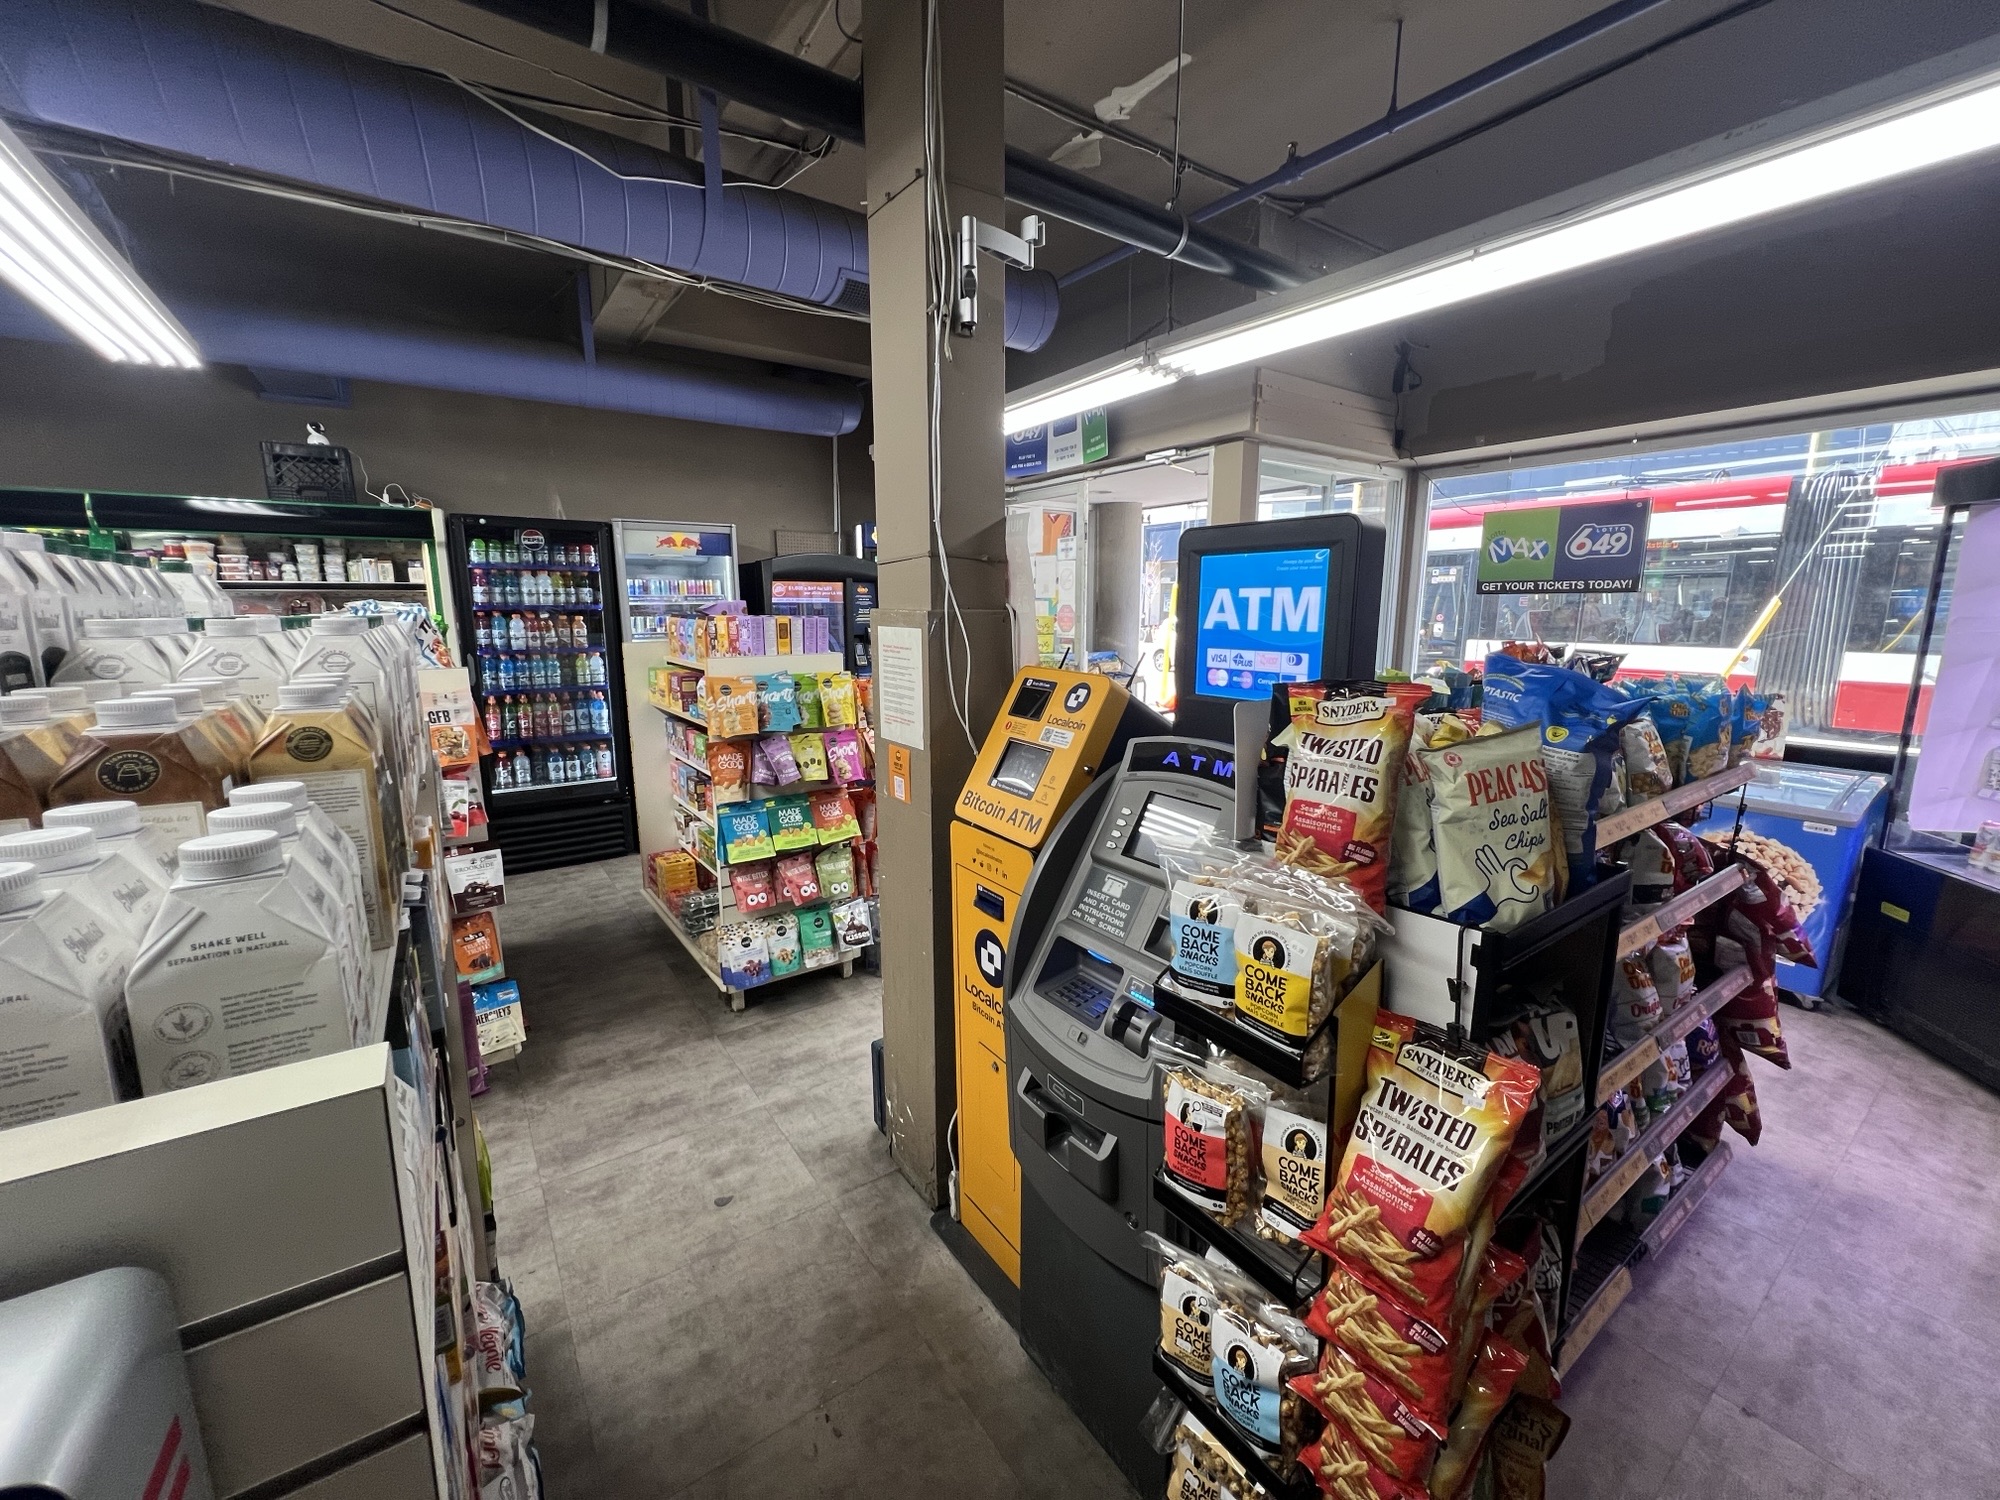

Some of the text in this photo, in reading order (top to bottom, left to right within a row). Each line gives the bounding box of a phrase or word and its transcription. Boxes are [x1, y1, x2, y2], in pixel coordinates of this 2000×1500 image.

[1488, 536, 1548, 564] MAX
[1570, 527, 1628, 556] 649
[1482, 579, 1633, 591] GET YOUR TICKETS TODAY!
[1203, 586, 1322, 633] ATM
[1210, 654, 1228, 663] VISA
[428, 709, 451, 724] GFB
[1046, 714, 1086, 731] Localcoin
[718, 752, 744, 762] MADE
[778, 807, 801, 818] MADE
[820, 800, 842, 812] MADE
[820, 809, 843, 818] GOOD
[962, 788, 1043, 835] Bitcoin ATM
[1489, 798, 1548, 831] Sea Salt
[732, 814, 758, 825] MADE
[734, 823, 758, 832] GOOD
[779, 816, 803, 824] GOOD
[1294, 816, 1342, 832] Assaisonnés
[1504, 830, 1546, 853] Chips
[454, 862, 495, 874] BROOKSIDE
[736, 870, 768, 883] WISE BITES
[1083, 896, 1128, 919] AND FOLLOW
[1086, 888, 1130, 911] INSERT CARD
[1072, 909, 1125, 938] ON THE SCREEN
[1078, 903, 1124, 928] INSTRUCTIONS
[190, 932, 267, 951] SHAKE WELL
[1182, 924, 1220, 944] COME
[167, 940, 290, 967] SEPARATION IS NATURAL
[1180, 948, 1219, 966] SNACKS
[1181, 936, 1220, 956] BACK
[1184, 960, 1213, 972] POPCORN
[1245, 964, 1288, 992] COME
[1245, 977, 1285, 1005] BACK
[1245, 990, 1285, 1015] SNACKS
[972, 1000, 995, 1025] Bitcoin
[1250, 1002, 1279, 1020] POPCORN
[1403, 1048, 1481, 1090] SNYDER'S
[1376, 1077, 1478, 1151] TWISTED
[1174, 1126, 1206, 1150] COME
[1384, 1112, 1400, 1126] Sticks
[1436, 1140, 1444, 1148] de
[1173, 1149, 1206, 1171] SNACKS
[1174, 1137, 1206, 1163] BACK
[1354, 1110, 1466, 1192] SPIRALES
[1278, 1156, 1320, 1181] COME
[1280, 1170, 1319, 1195] BACK
[1280, 1182, 1318, 1204] SNACKS
[1360, 1174, 1414, 1212] Assaisonnés
[1267, 1213, 1276, 1224] 225
[1175, 1318, 1211, 1343] COME
[1175, 1328, 1211, 1353] BACK
[1221, 1368, 1261, 1396] COME
[1221, 1380, 1260, 1410] BACK
[1224, 1392, 1260, 1420] SNACKS
